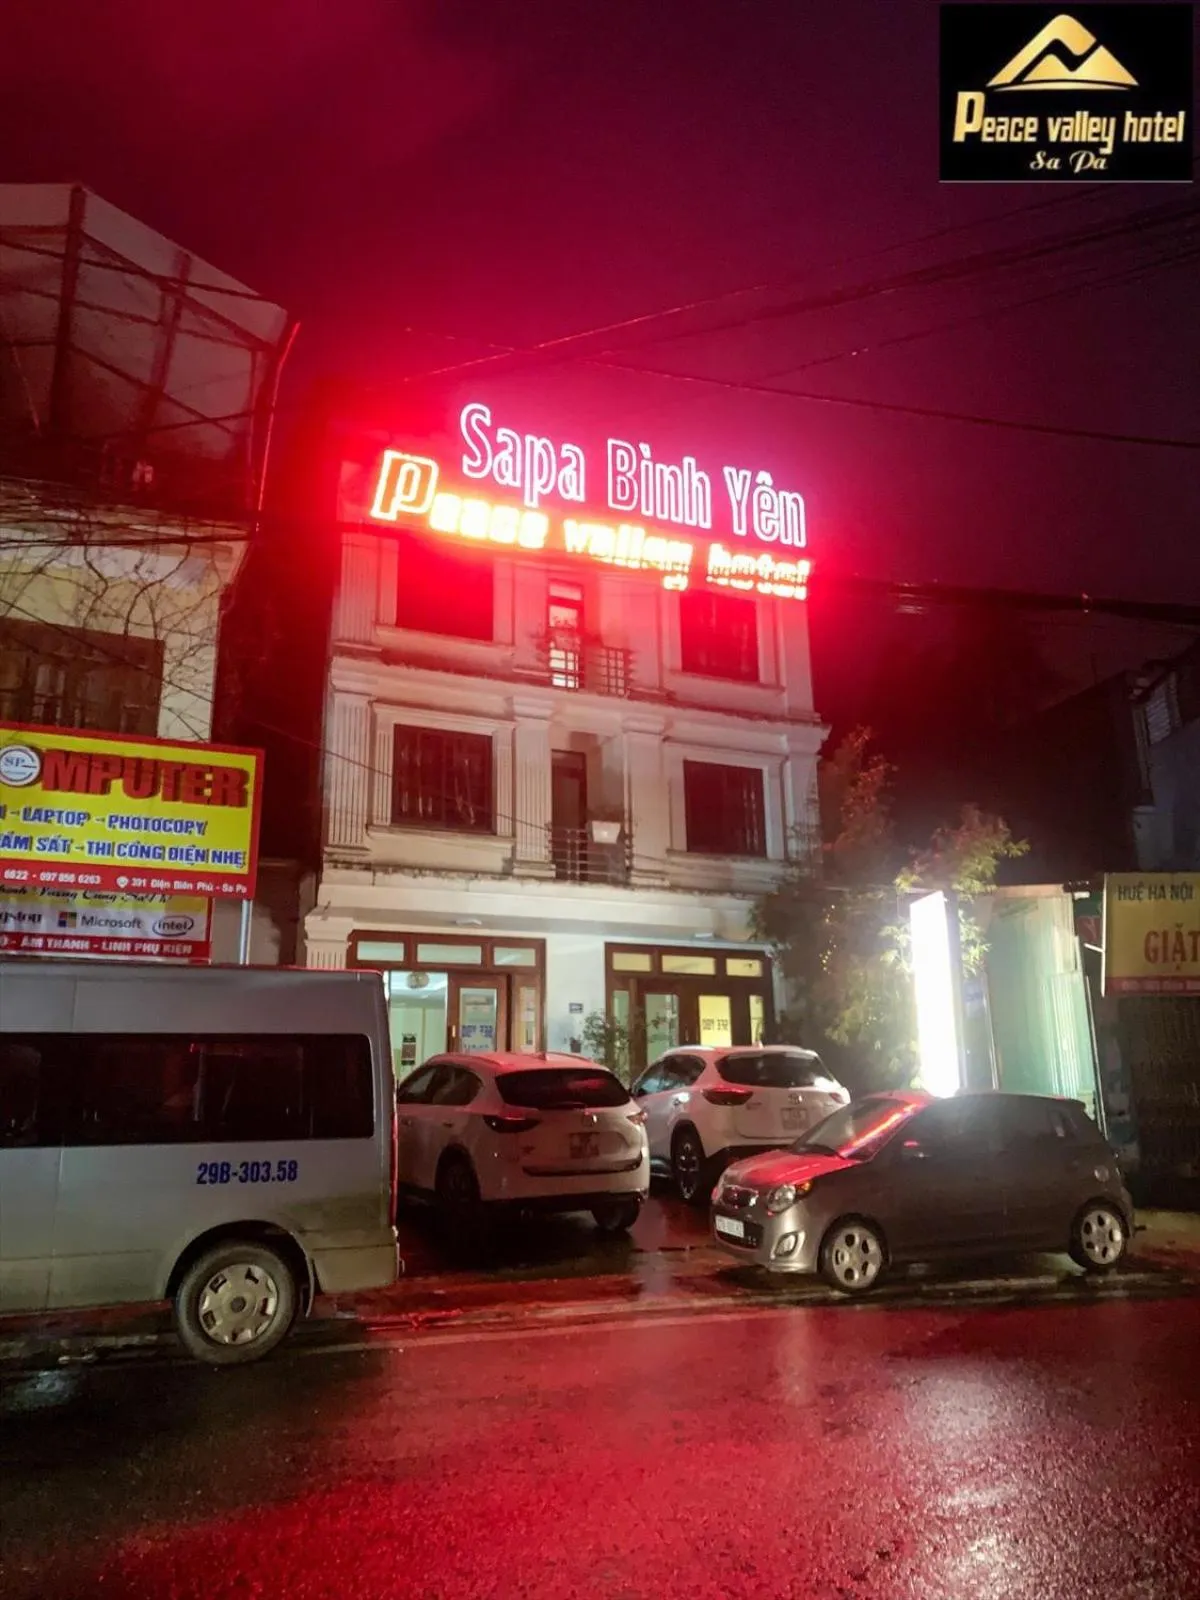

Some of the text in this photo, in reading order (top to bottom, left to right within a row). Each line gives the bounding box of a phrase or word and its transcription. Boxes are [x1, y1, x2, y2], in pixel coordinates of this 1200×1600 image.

[459, 402, 807, 548] Sapa Bình Yên
[41, 748, 249, 809] MPUTER
[22, 805, 90, 827] LAPTOP
[106, 814, 208, 836] PHOTOCOPY
[87, 840, 115, 857] THI
[80, 914, 142, 930] Microsoft
[195, 1159, 299, 1186] 29B-303.58
